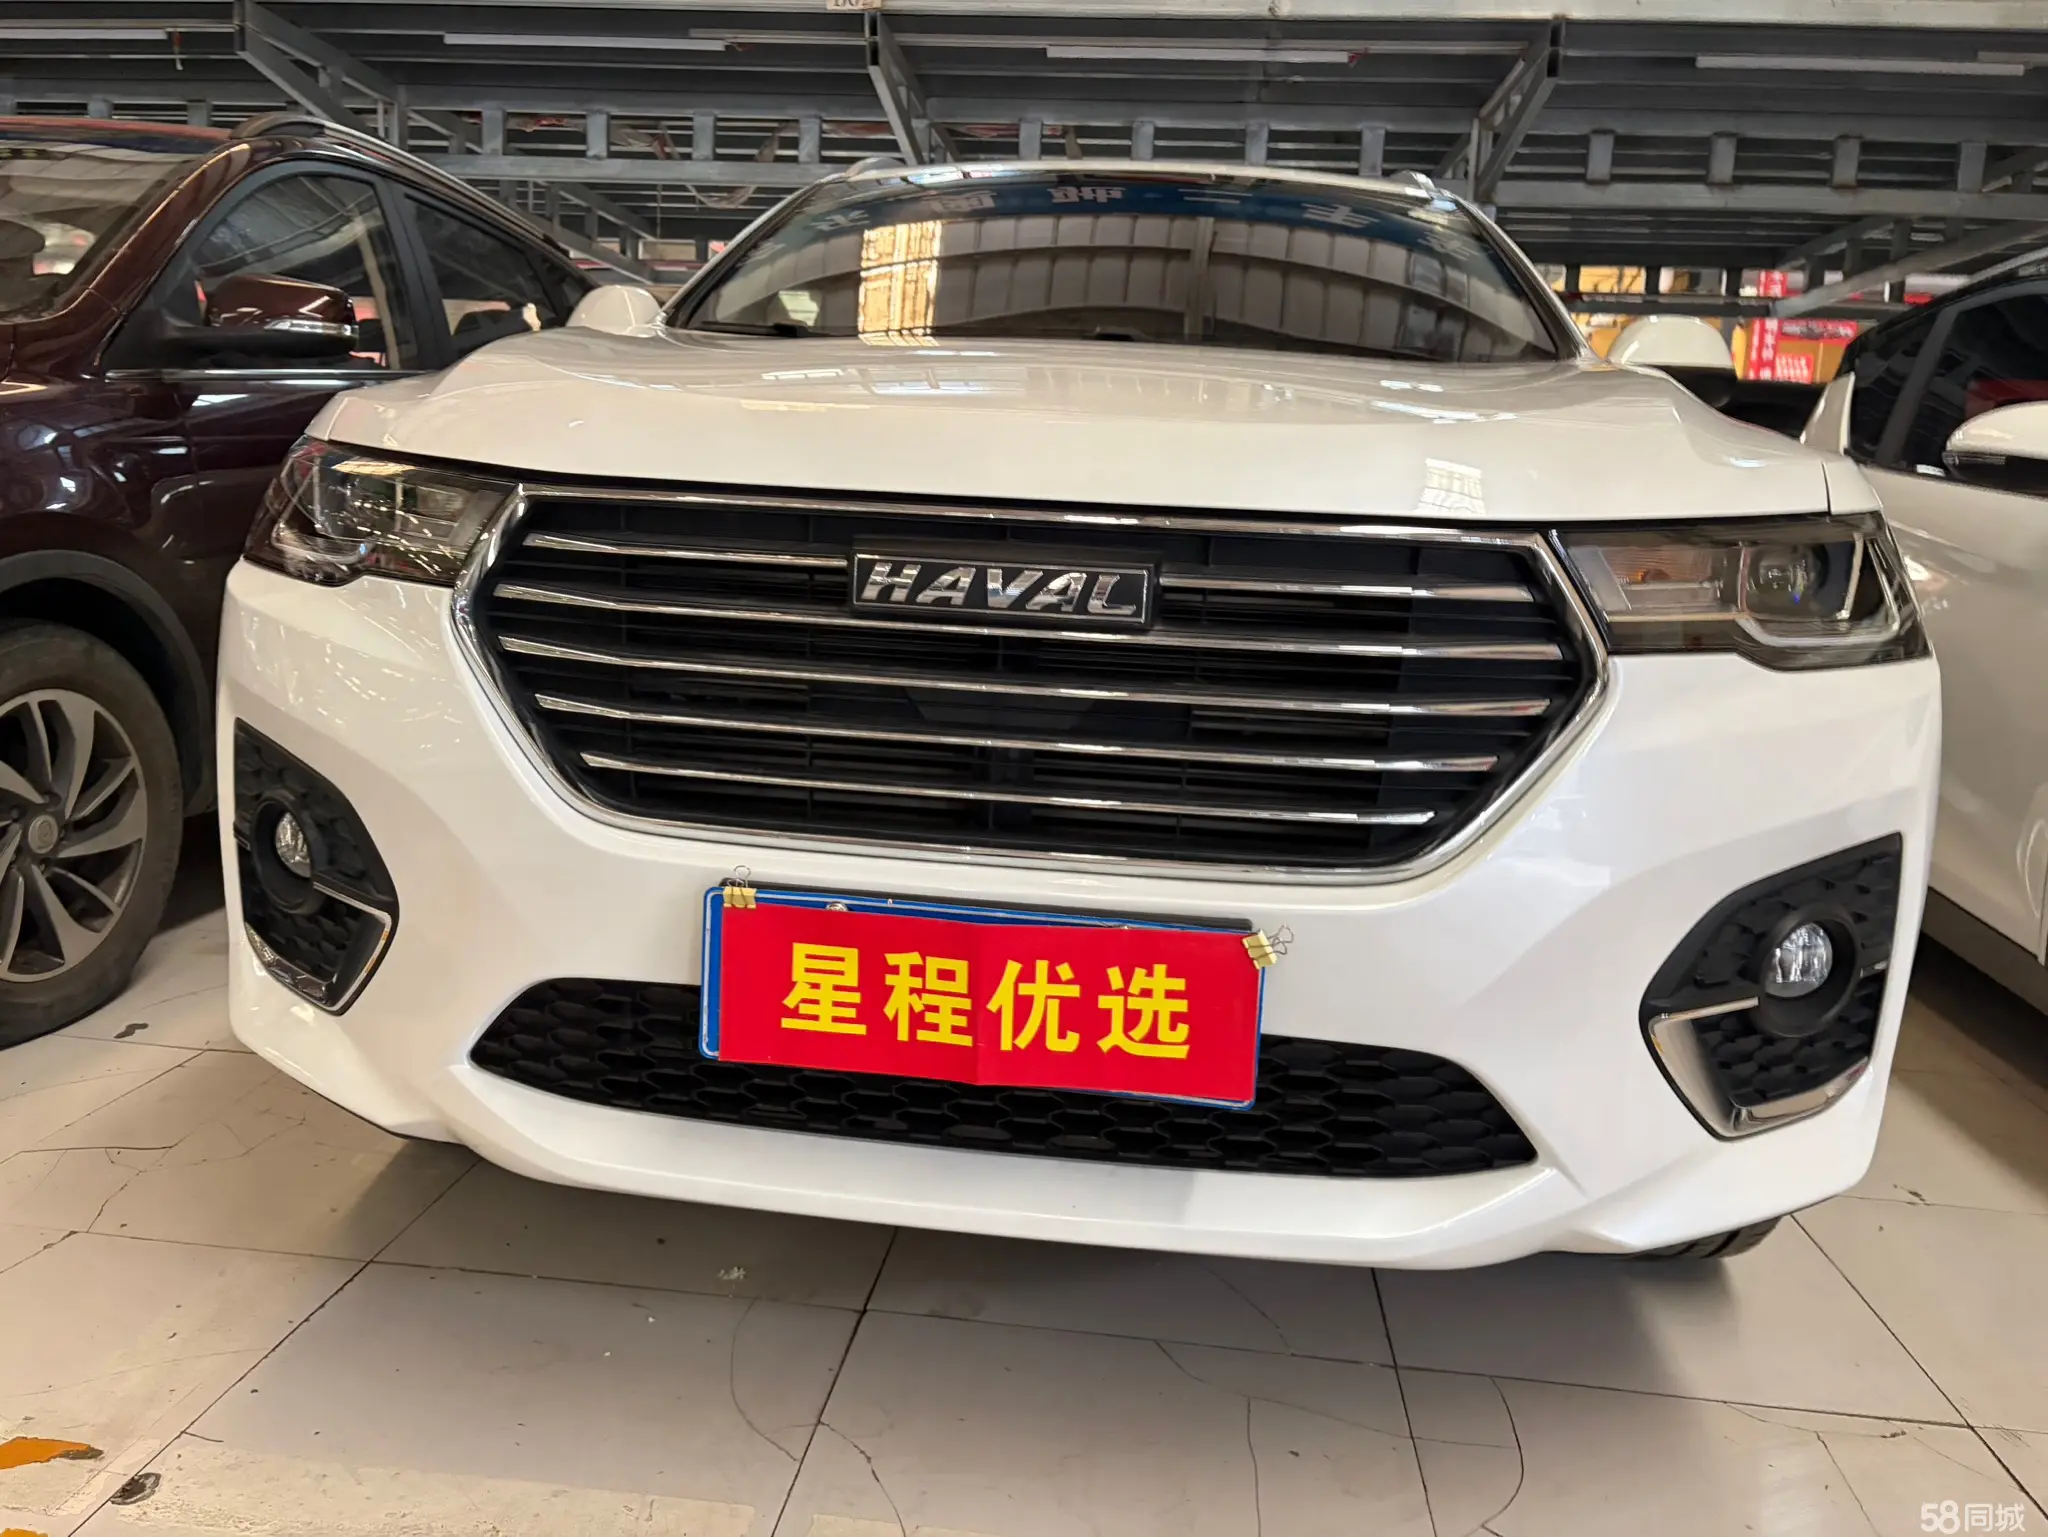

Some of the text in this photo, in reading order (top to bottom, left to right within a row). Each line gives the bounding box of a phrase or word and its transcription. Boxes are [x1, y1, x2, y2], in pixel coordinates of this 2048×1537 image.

[861, 562, 1136, 614] HAVAL
[781, 942, 1190, 1059] 星程优选
